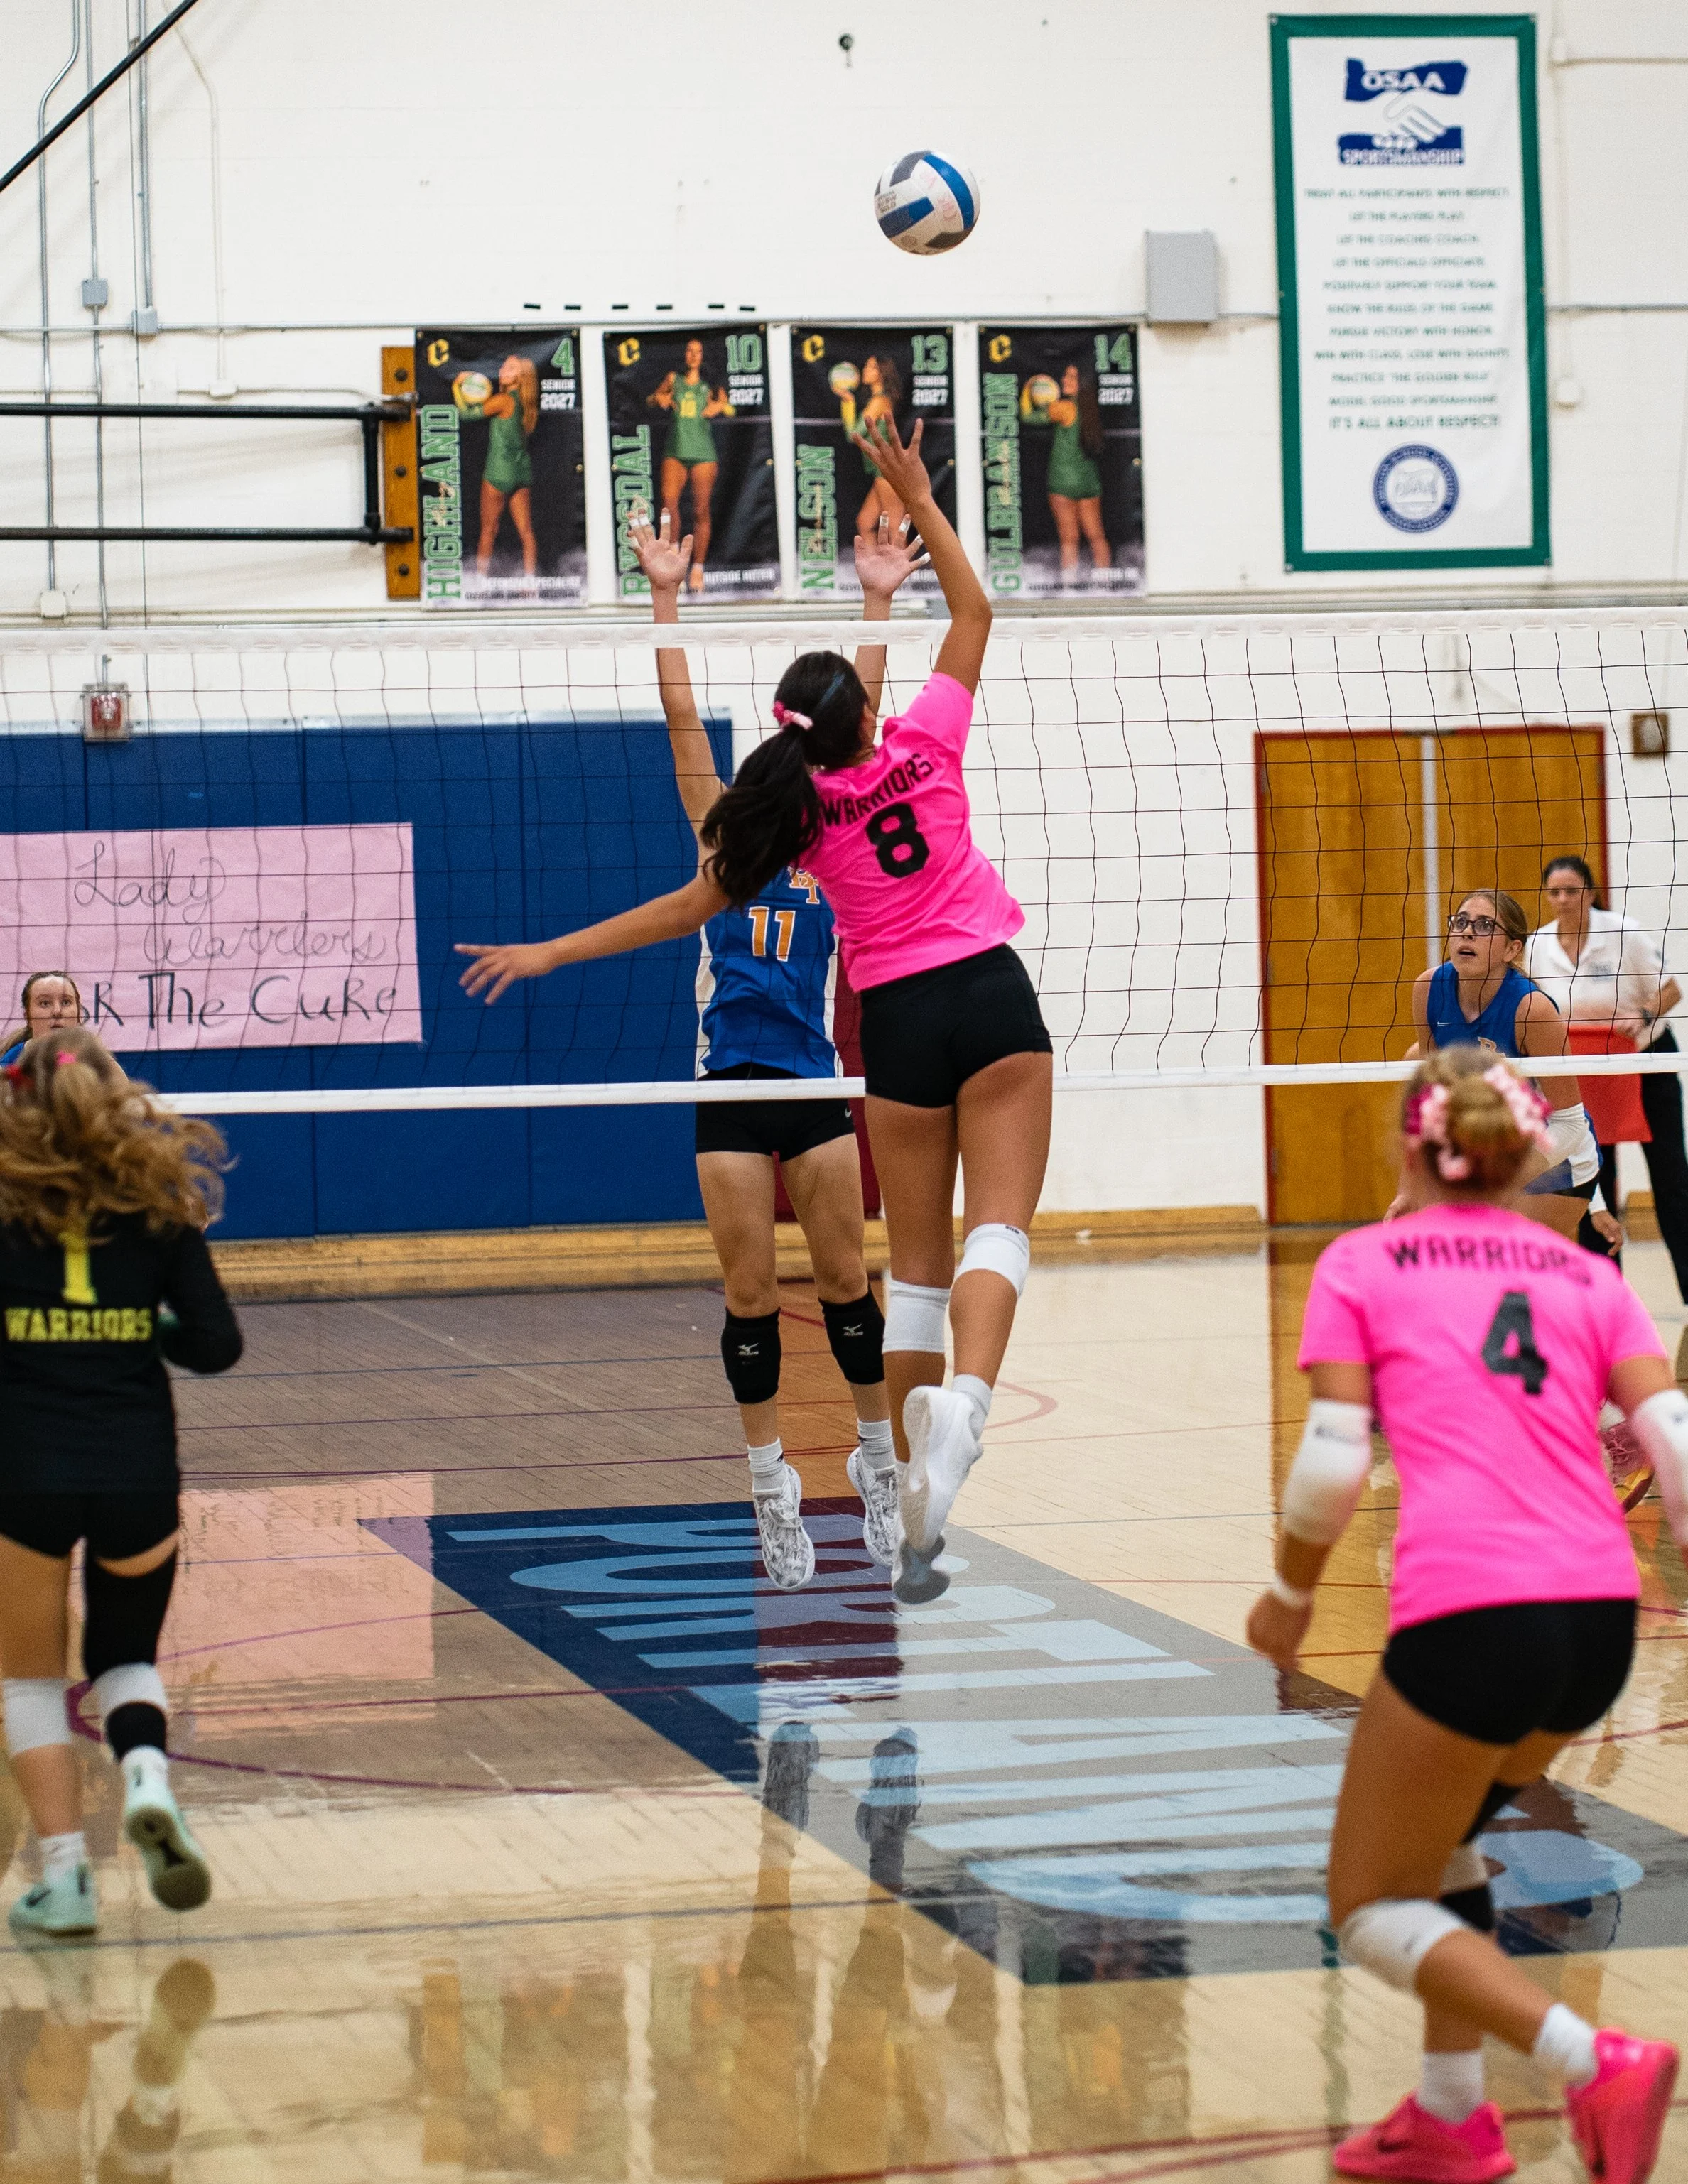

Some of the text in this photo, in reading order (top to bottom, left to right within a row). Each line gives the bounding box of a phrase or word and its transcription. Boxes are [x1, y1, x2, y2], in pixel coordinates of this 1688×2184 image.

[1360, 72, 1446, 91] OSAA
[551, 338, 575, 377] 4
[725, 334, 762, 374] 10
[911, 335, 948, 374] 13
[1094, 333, 1133, 374] 14
[421, 404, 462, 599] HIGHLAND
[797, 444, 838, 590] NELSON
[821, 752, 934, 827] WARRIORS
[866, 803, 930, 879] 8
[74, 840, 227, 924] Lady
[749, 906, 796, 962] 11
[58, 1231, 98, 1305] 1
[4, 1306, 154, 1342] WARRIORS
[1481, 1289, 1549, 1396] 4
